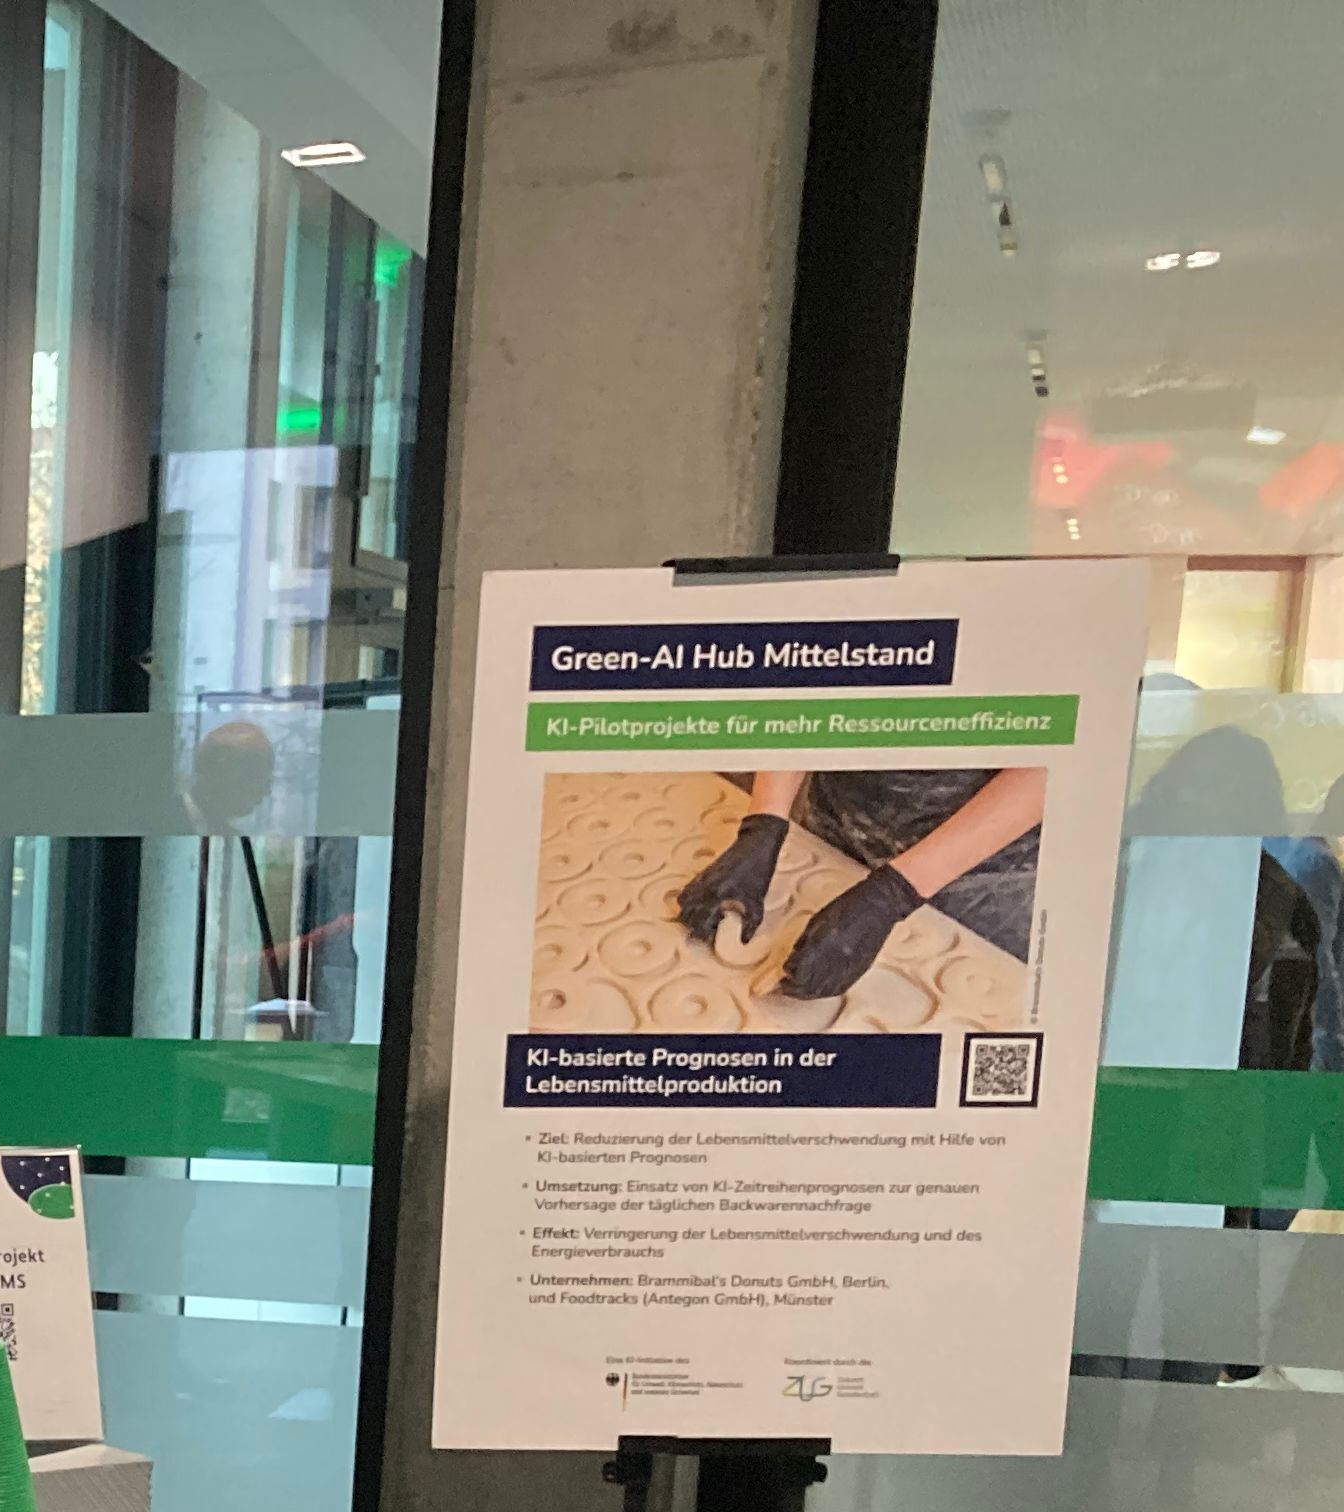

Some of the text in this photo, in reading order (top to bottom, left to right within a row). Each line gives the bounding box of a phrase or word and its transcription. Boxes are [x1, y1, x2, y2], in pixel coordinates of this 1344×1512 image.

[550, 639, 936, 672] Green-AI Hub Mittelstand
[546, 711, 1052, 739] KI-Pilotprojekte für mehr Ressourceneffizienz
[527, 1047, 837, 1071] KI-basierte Prognosen in der
[525, 1075, 783, 1098] Lebensmittelproduktion
[538, 1132, 1006, 1148] Ziel: Reduzierung der Lebensmittelverschwendung mit Hilfe von
[537, 1151, 708, 1166] KI-basierten Prognosen
[535, 1180, 980, 1197] Umsetzung: Einsatz von KI-Zeitreihenprognosen zur genauen
[534, 1198, 872, 1215] Vorhersage der täglichen Backwarennachfrage
[532, 1226, 983, 1244] Effekt: Verringerung der Lebensmittelverschwendung und des
[531, 1245, 665, 1260] Energieverbrauchs
[530, 1273, 634, 1287] Unternehmen:
[731, 1275, 783, 1288] Donuts
[787, 1275, 838, 1289] GmbH,
[529, 1292, 556, 1305] und
[560, 1292, 639, 1305] Foodtracks
[643, 1293, 710, 1307] (Antegon
[774, 1293, 834, 1306] Münster
